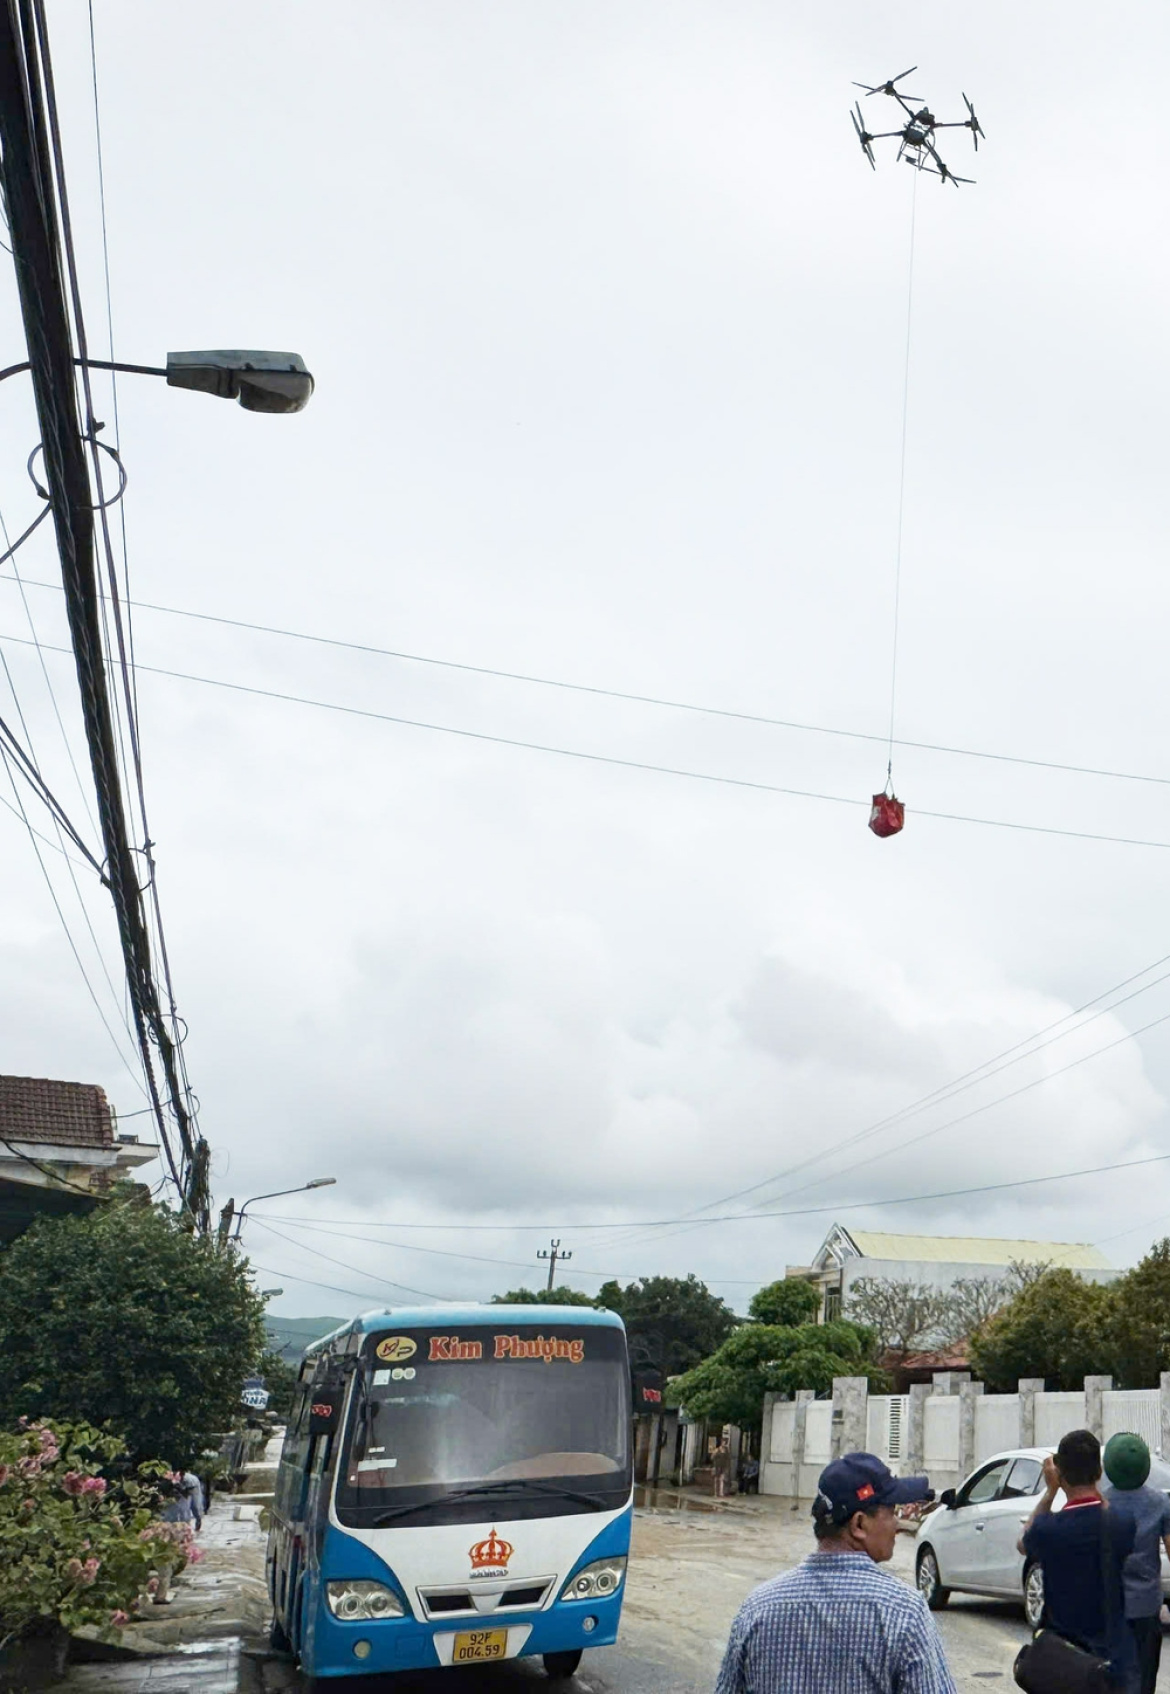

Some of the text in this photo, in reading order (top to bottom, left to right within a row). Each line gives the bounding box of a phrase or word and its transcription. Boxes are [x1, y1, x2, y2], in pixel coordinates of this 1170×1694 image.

[428, 1335, 584, 1364] Kim Phượng
[459, 1644, 500, 1659] 004.59
